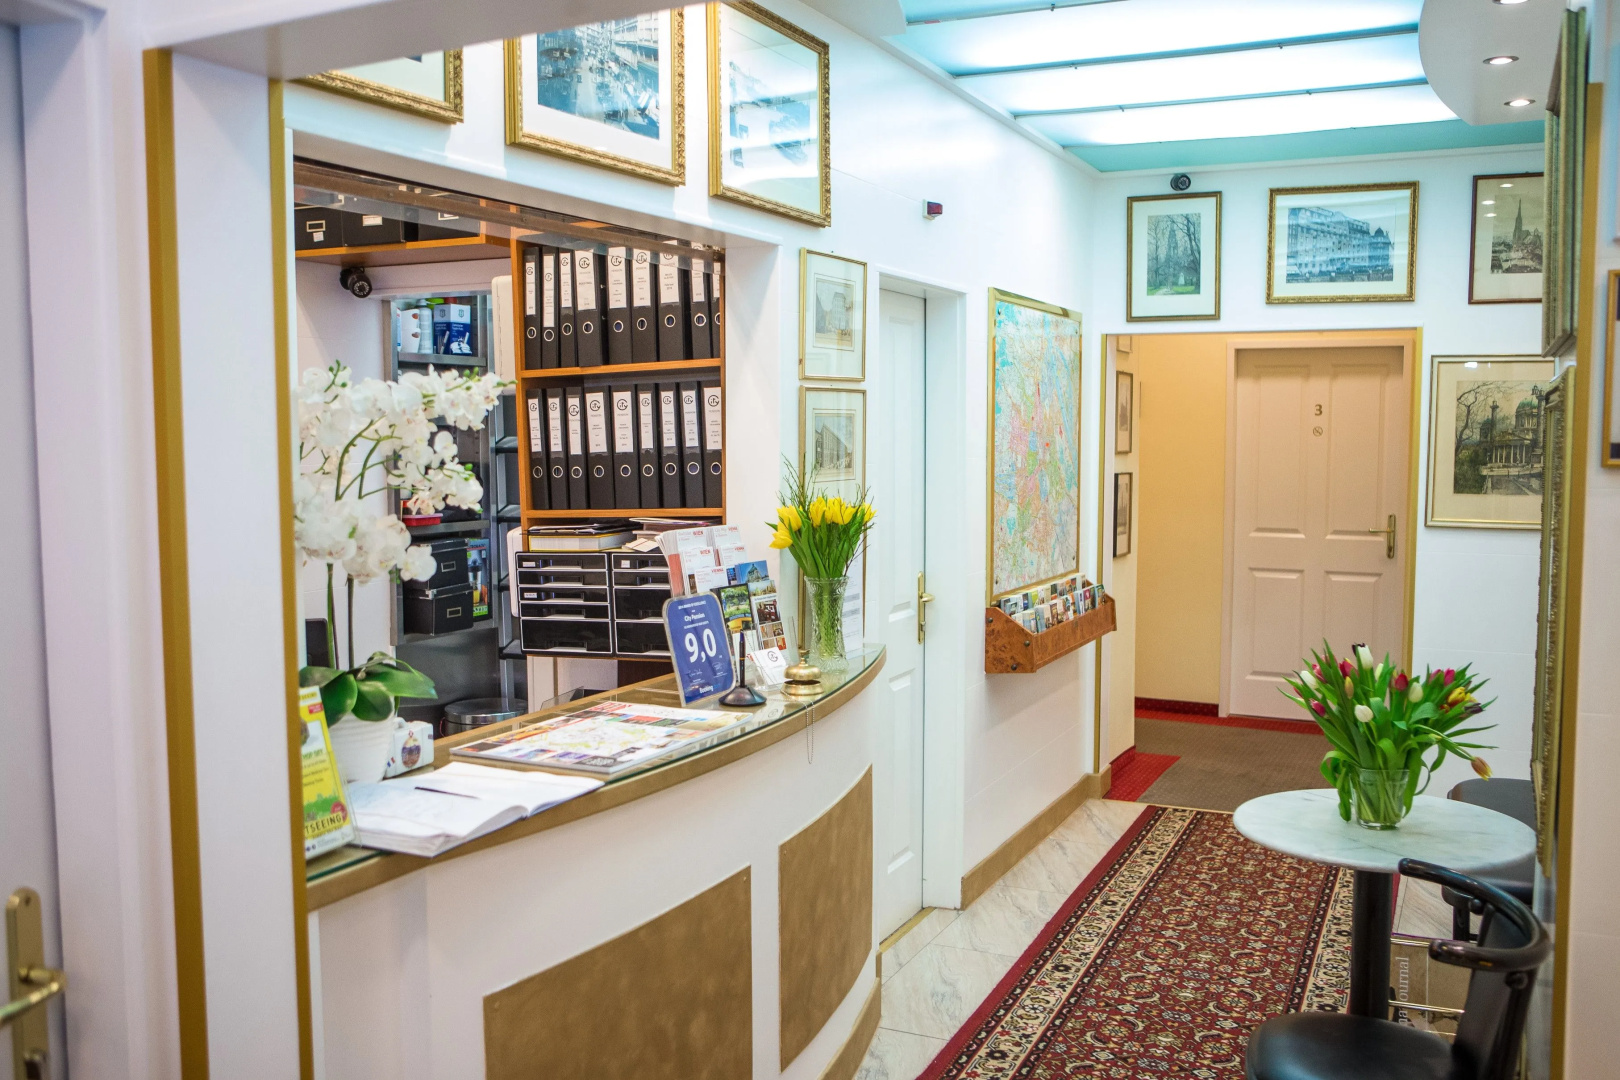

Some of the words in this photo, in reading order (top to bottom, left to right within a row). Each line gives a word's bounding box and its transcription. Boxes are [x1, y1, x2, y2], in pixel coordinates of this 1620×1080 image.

[1314, 403, 1323, 416] 3
[684, 628, 717, 663] 9,0
[305, 814, 342, 834] TSEEING
[1395, 956, 1409, 1002] ournal
